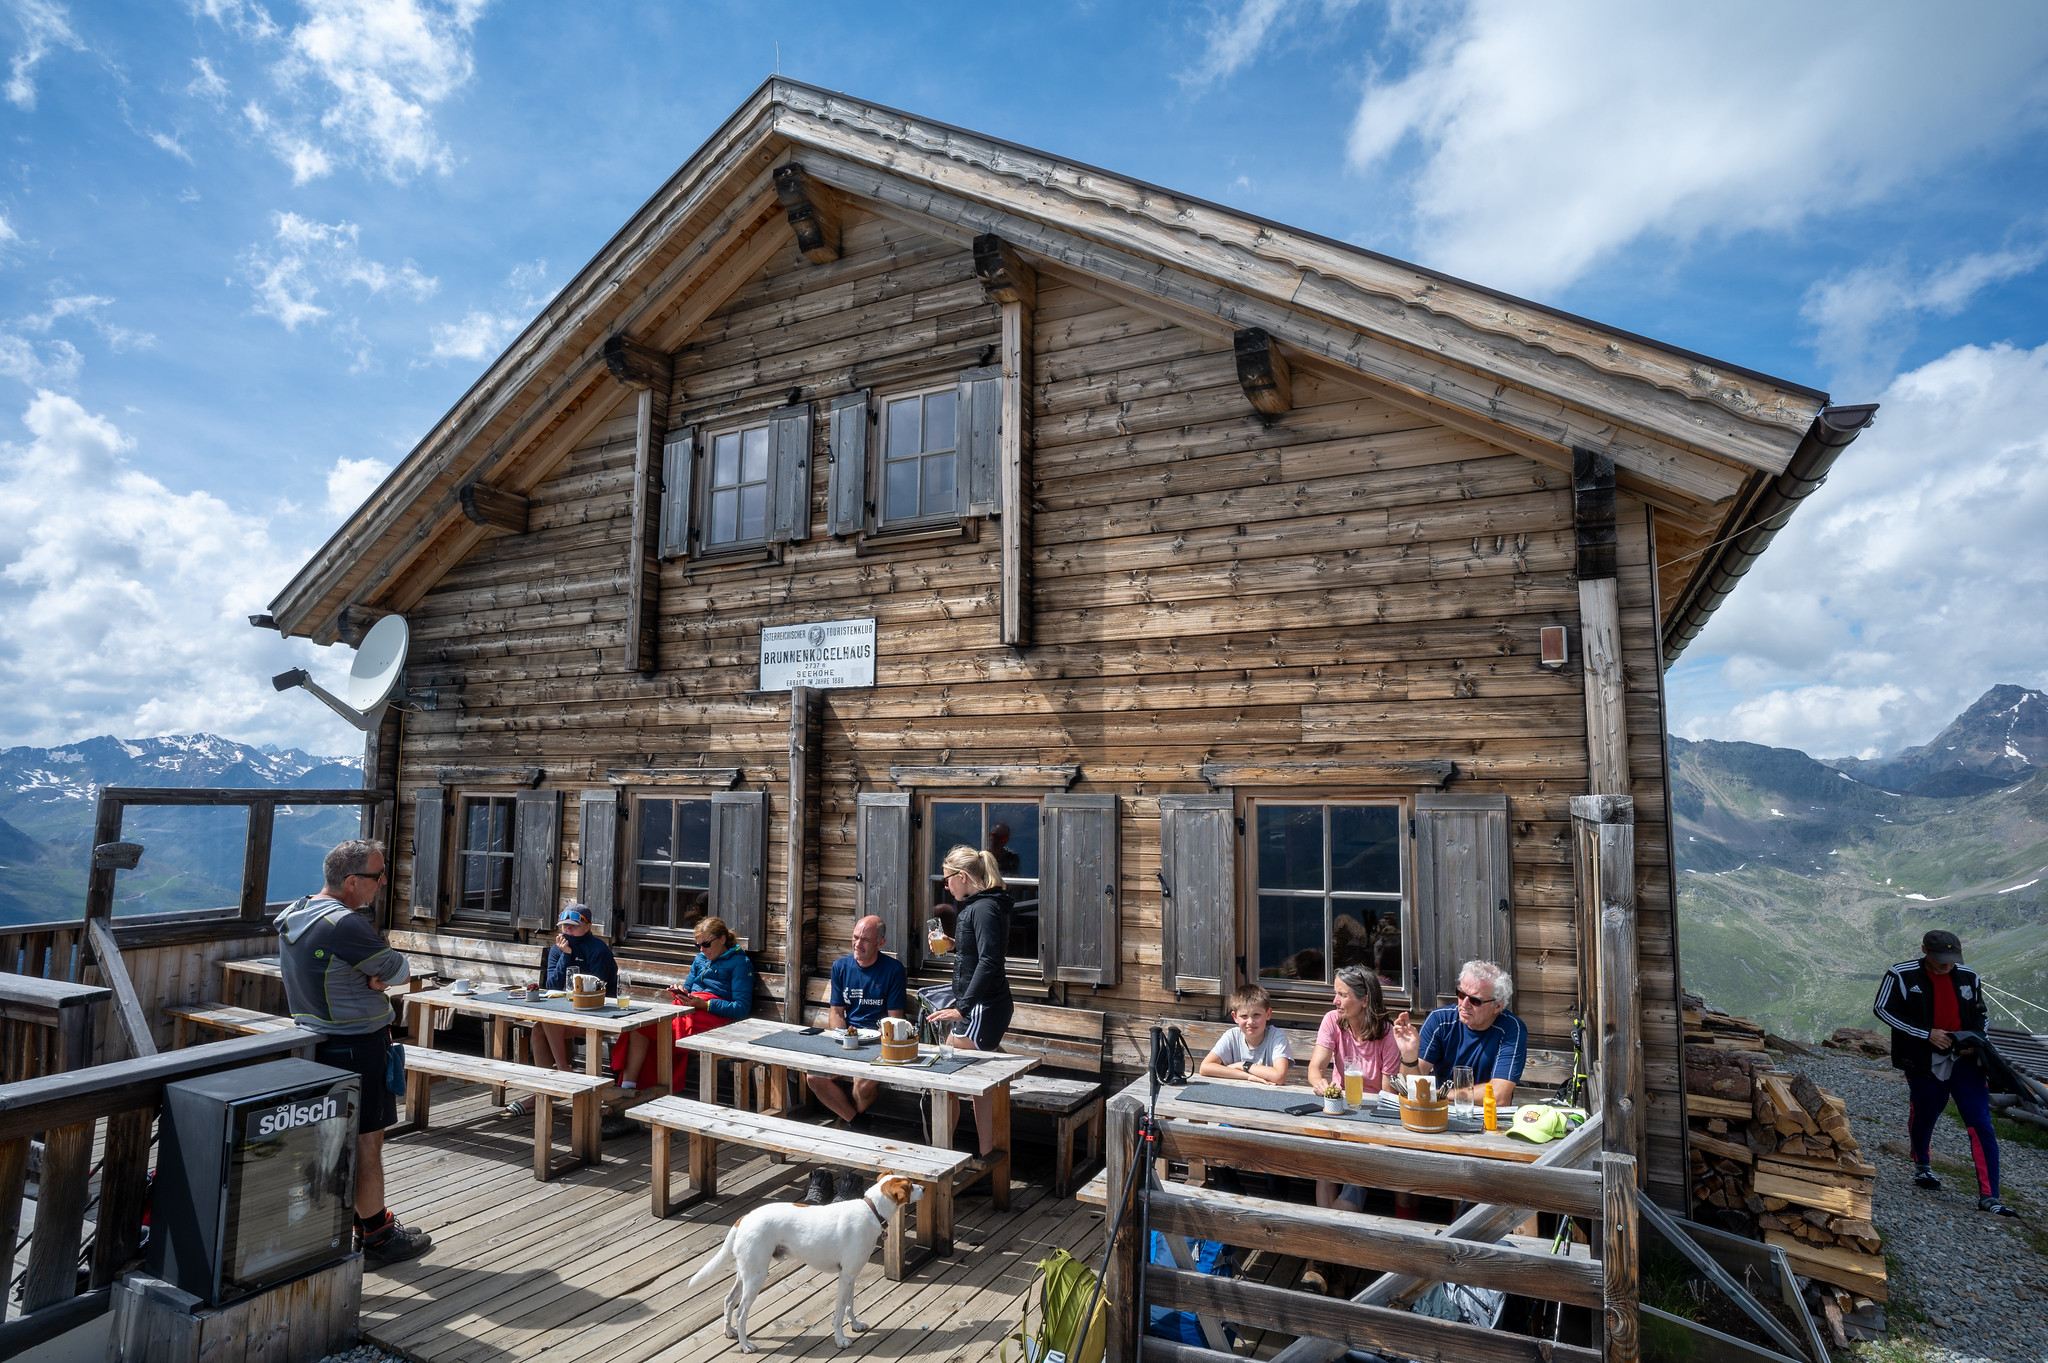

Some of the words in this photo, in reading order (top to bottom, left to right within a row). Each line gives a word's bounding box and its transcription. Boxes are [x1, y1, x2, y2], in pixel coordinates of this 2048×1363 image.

[826, 624, 873, 637] TOURISTENKLUB
[764, 645, 871, 665] BRUNNENKOGELHAUS
[260, 1096, 337, 1135] sölsch
